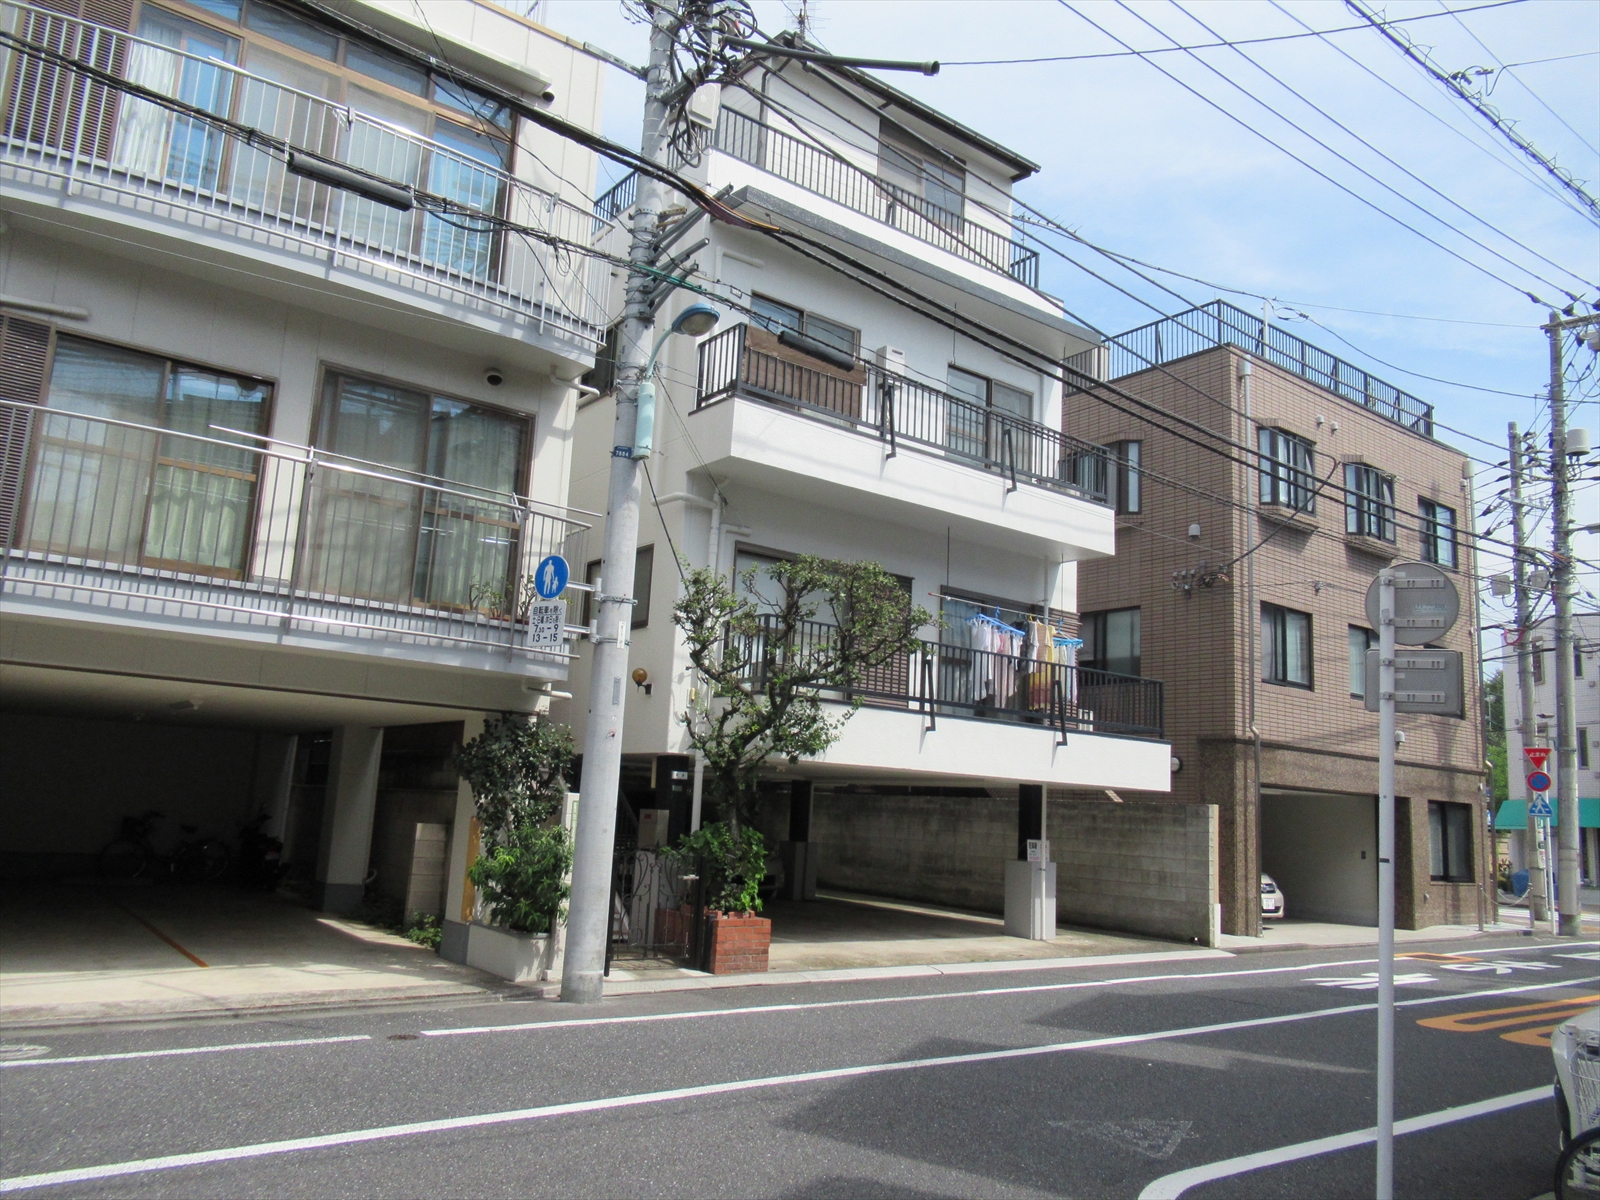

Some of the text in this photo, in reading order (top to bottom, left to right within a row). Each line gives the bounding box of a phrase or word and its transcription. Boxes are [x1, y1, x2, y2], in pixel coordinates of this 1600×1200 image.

[533, 605, 562, 614] 自転車を除く
